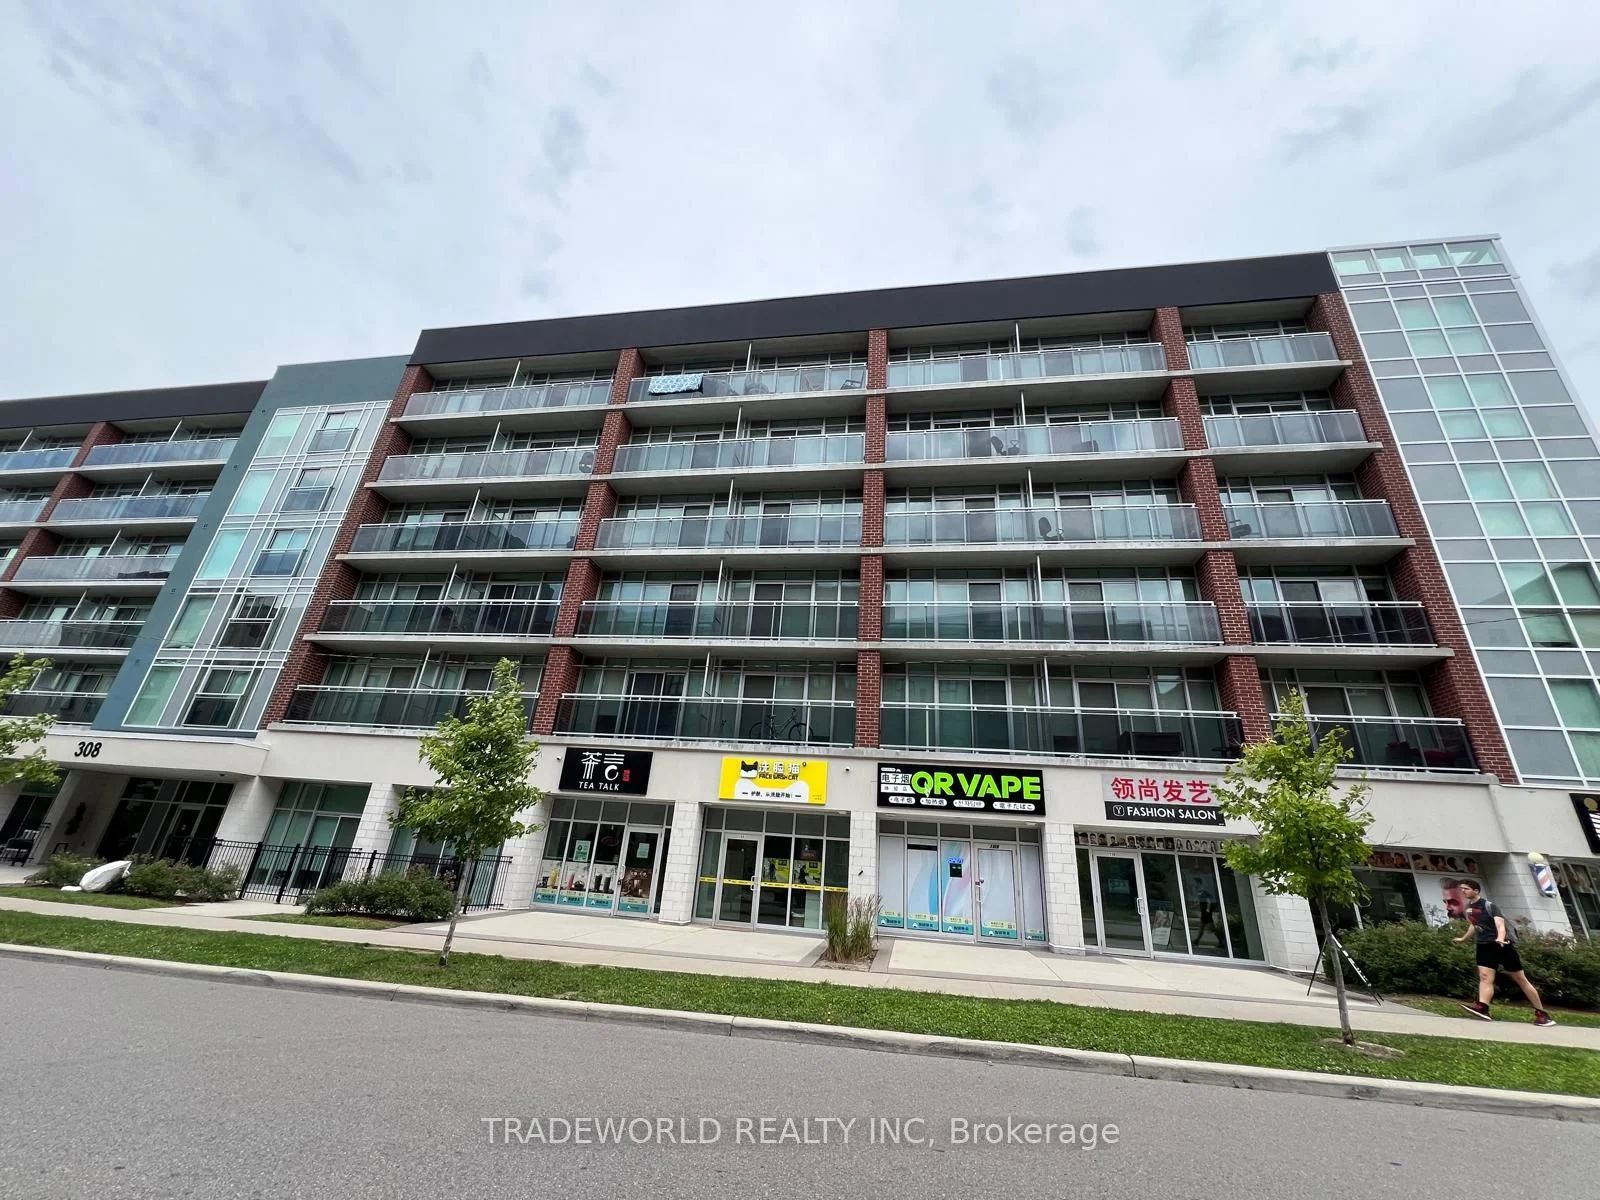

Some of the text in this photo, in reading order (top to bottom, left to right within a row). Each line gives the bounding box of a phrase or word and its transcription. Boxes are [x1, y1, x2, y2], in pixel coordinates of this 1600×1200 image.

[74, 741, 102, 758] 308
[579, 781, 620, 791] TEA TALK
[881, 773, 910, 785] 电子烟
[911, 771, 1041, 800] QR VAPE
[1110, 777, 1212, 803] 领尚发艺
[1127, 806, 1217, 820] FASHION SALON
